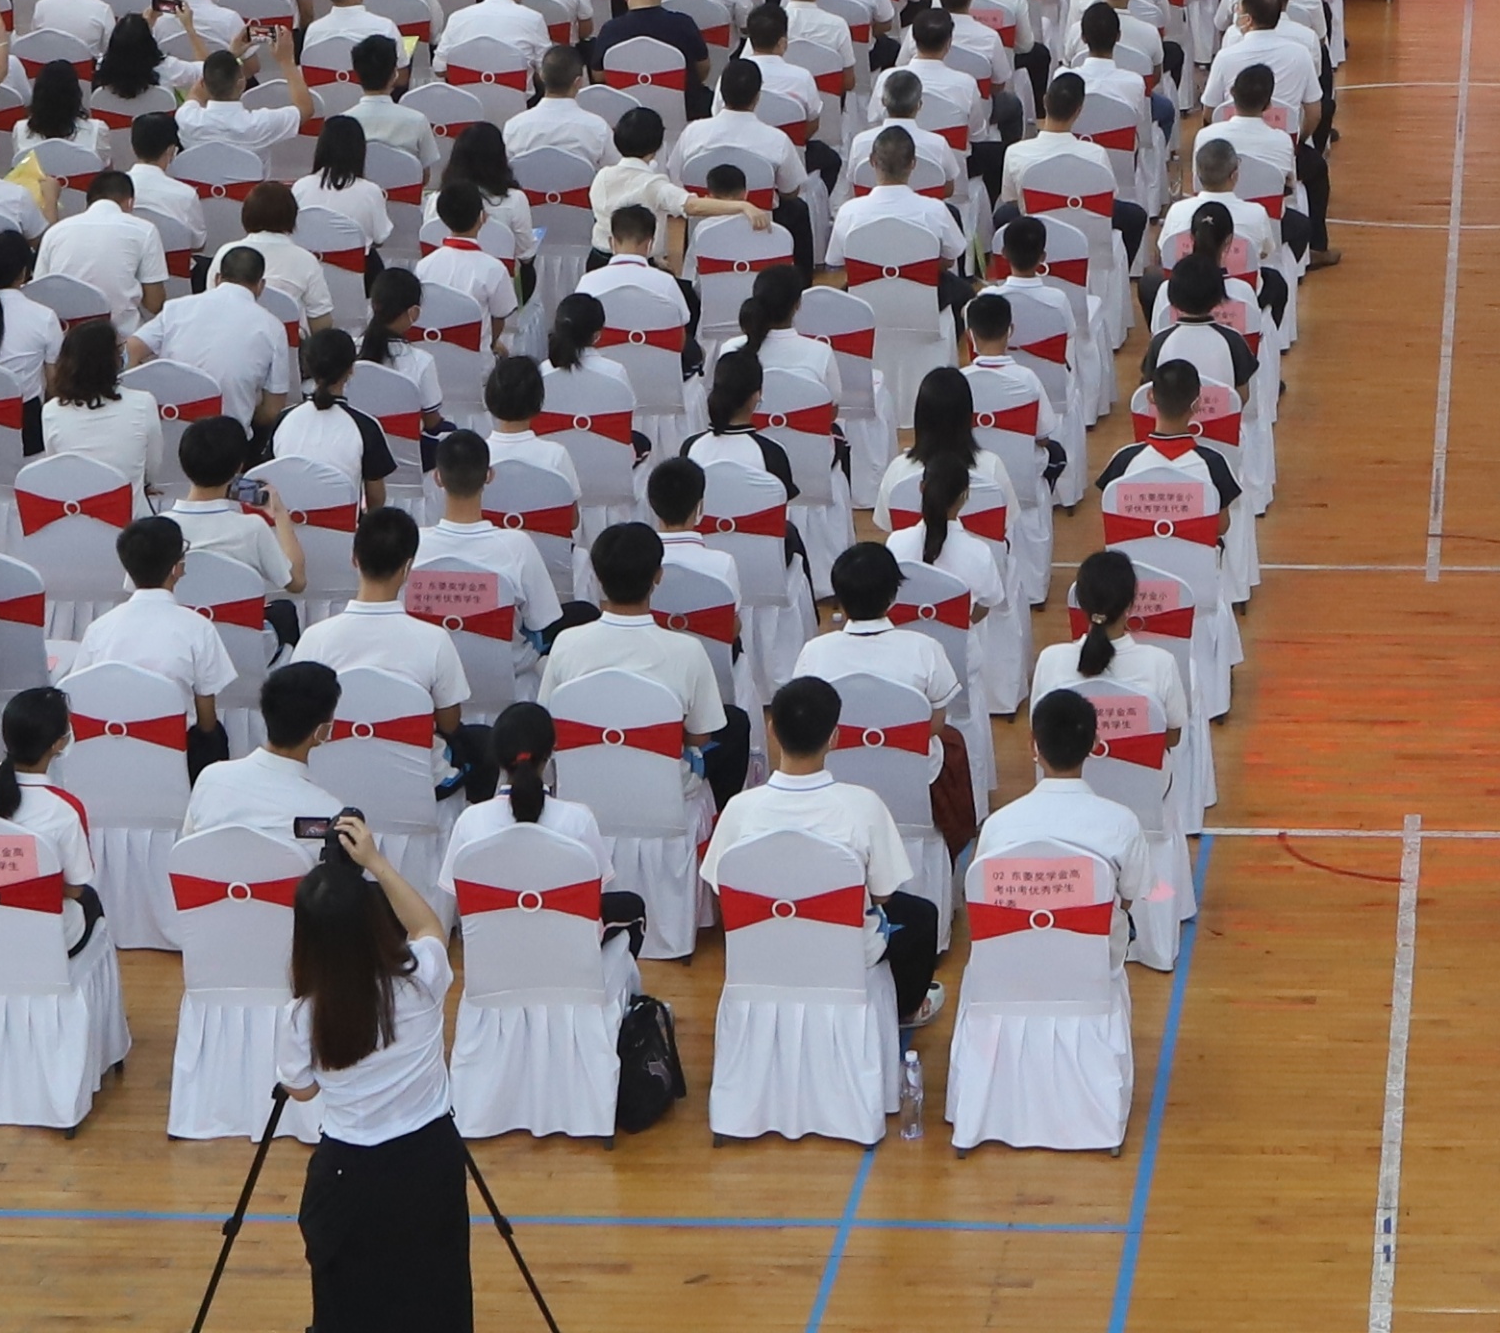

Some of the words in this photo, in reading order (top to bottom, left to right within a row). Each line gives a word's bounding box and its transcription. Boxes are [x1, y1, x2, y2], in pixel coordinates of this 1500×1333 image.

[1139, 493, 1194, 503] 东菱奖学金小
[1124, 504, 1189, 513] 学优秀学生代表
[429, 582, 488, 592] 东菱奖学金高
[413, 594, 481, 604] 考中考优秀学生
[993, 872, 1004, 880] 02
[1012, 870, 1080, 881] 东菱奖学金高
[994, 883, 1075, 896] 考中考优秀学生
